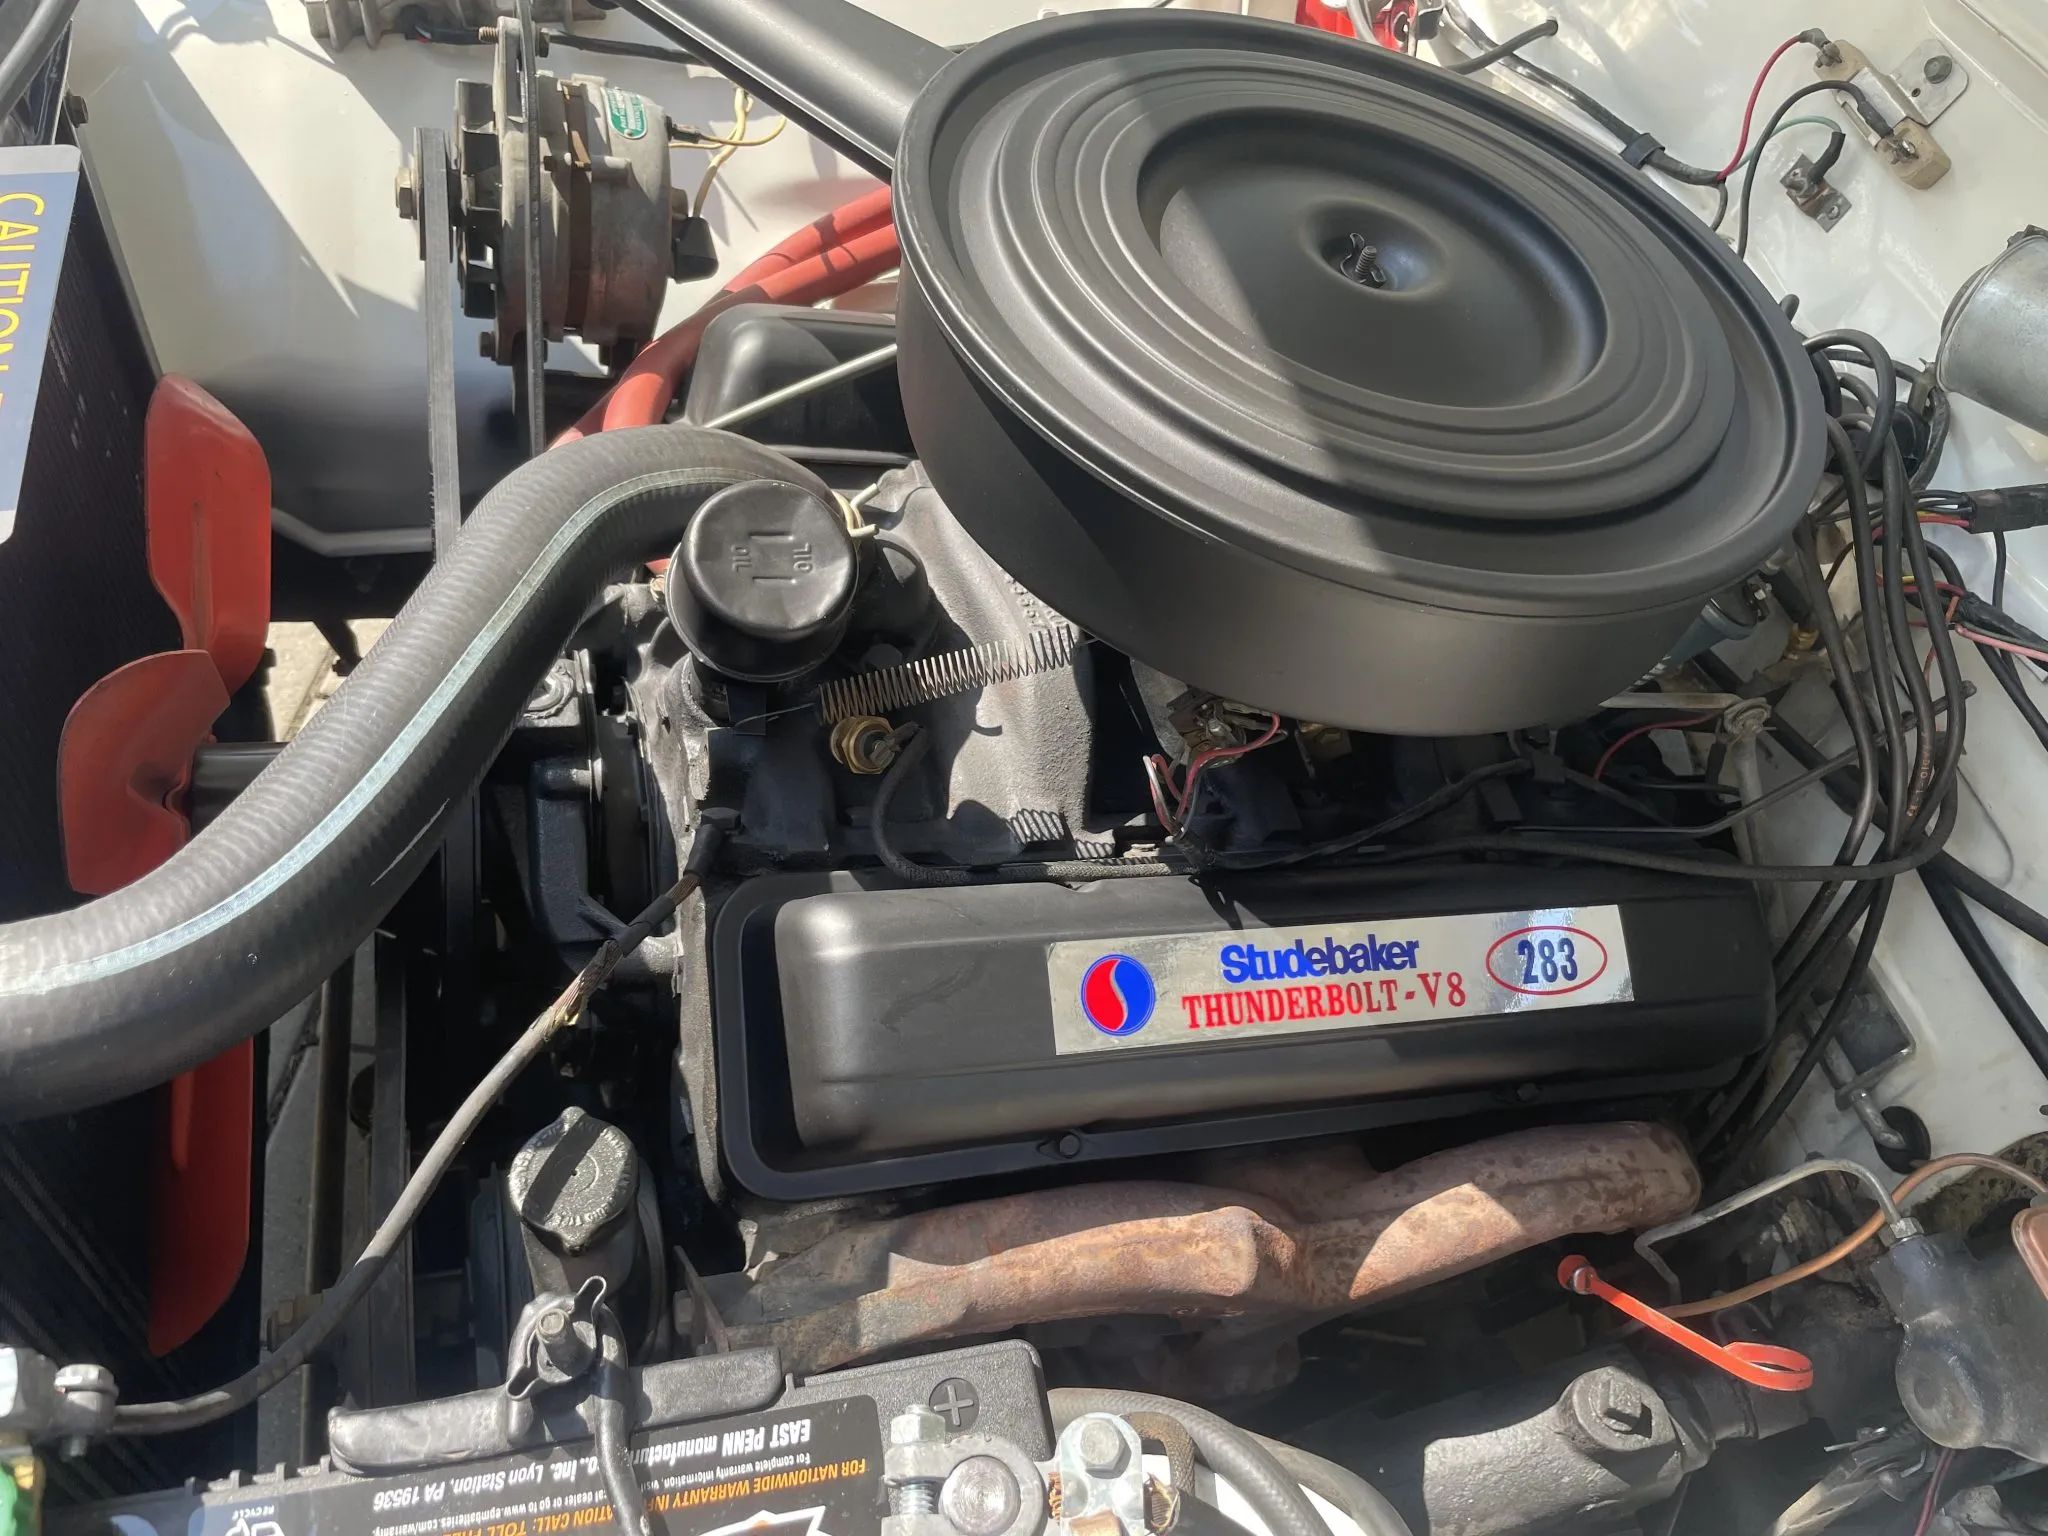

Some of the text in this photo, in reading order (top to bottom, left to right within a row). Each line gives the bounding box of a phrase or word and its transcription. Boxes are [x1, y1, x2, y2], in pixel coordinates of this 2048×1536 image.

[0, 193, 45, 371] CAUT
[792, 542, 814, 574] OIL
[1221, 933, 1420, 984] Studebaker
[1517, 937, 1579, 985] 283
[722, 1427, 765, 1457] PENN
[770, 1419, 811, 1449] EAST
[629, 1435, 718, 1467] manufactur
[796, 1452, 811, 1465] For
[508, 1462, 544, 1486] Lyon
[550, 1459, 577, 1483] inc.
[717, 1461, 753, 1480] warranty
[755, 1454, 794, 1474] complete
[841, 1458, 866, 1477] FOR
[451, 1470, 506, 1496] Station,
[753, 1463, 838, 1494] NATIONWIDE
[373, 1485, 420, 1512] 19536
[424, 1481, 446, 1503] PA
[540, 1496, 551, 1511] go
[553, 1496, 563, 1508] or
[565, 1491, 593, 1506] dealer
[672, 1479, 750, 1509] WARRANTY
[528, 1503, 538, 1514] to
[533, 1511, 570, 1534] CALL:
